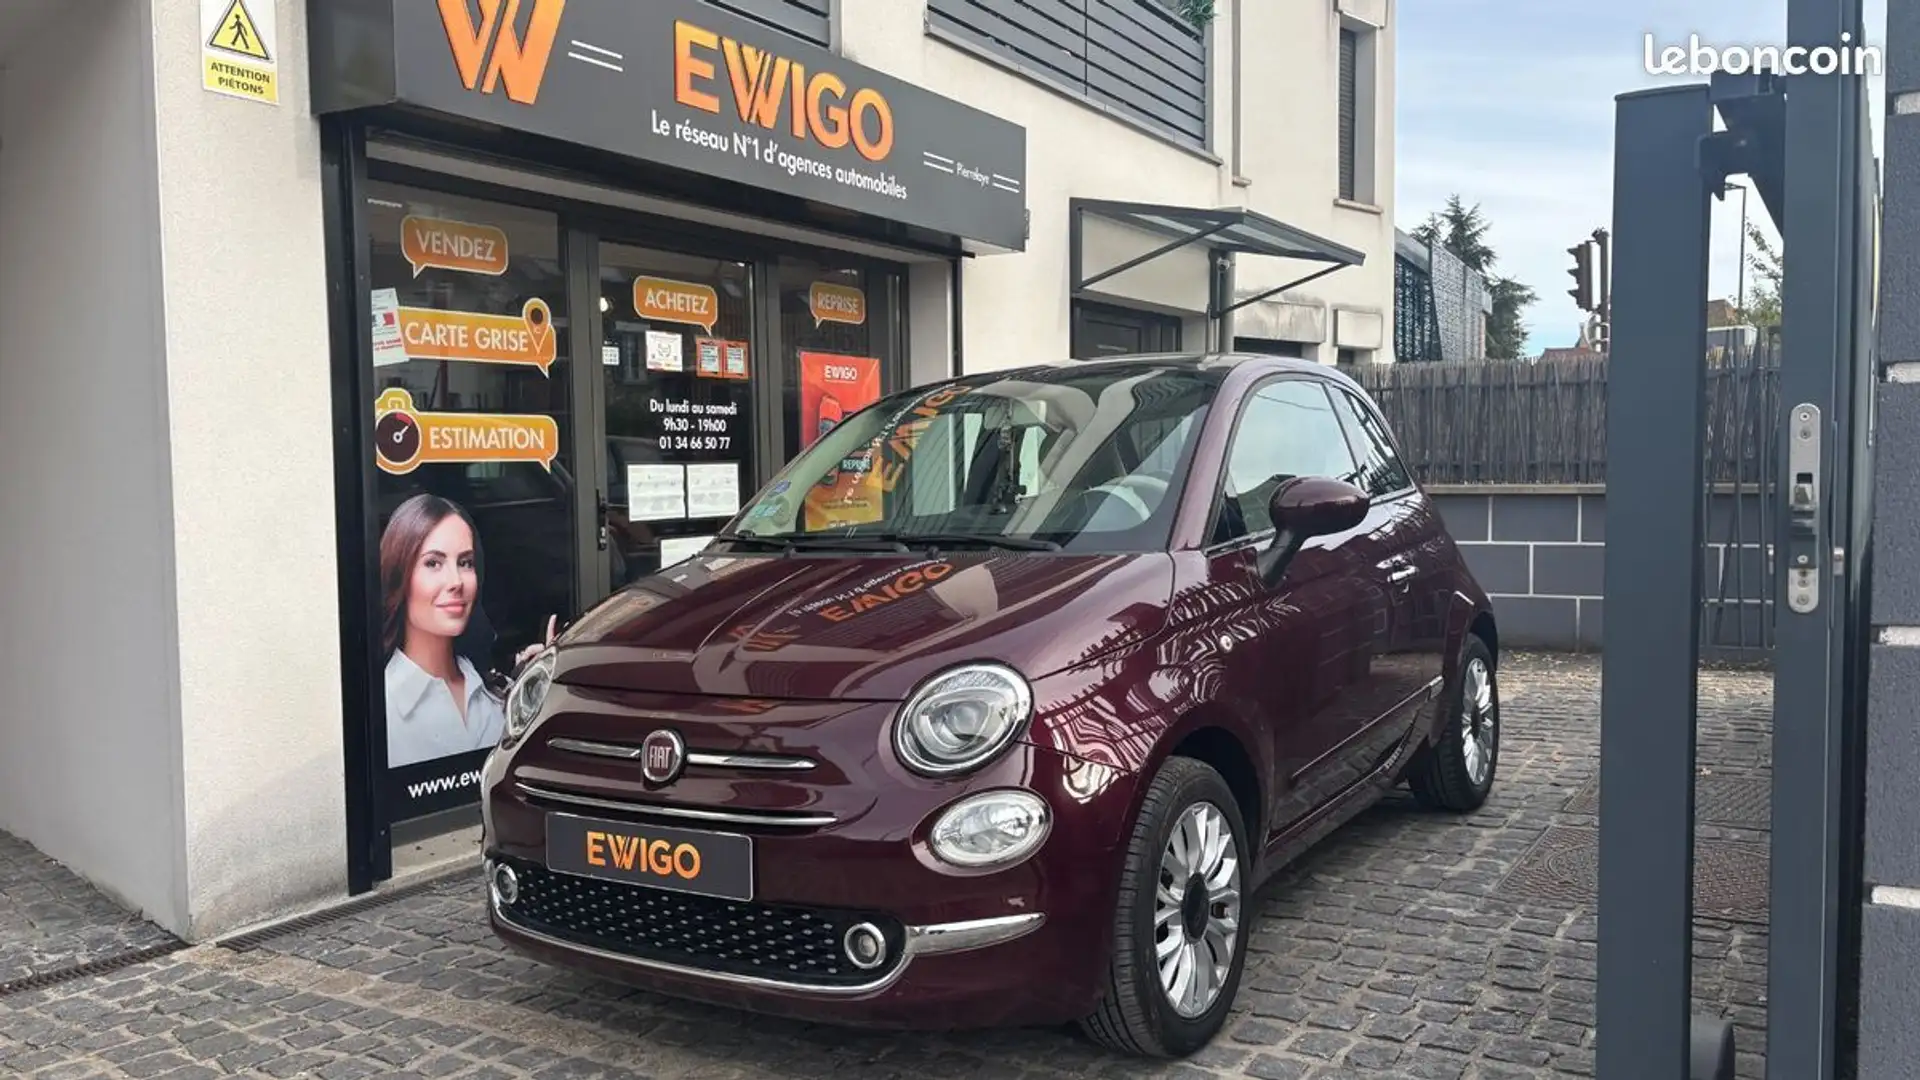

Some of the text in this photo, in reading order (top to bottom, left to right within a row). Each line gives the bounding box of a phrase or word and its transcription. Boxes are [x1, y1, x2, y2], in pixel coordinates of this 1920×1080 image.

[210, 61, 270, 84] ATTENTION
[218, 76, 264, 95] PIÉTONS
[674, 19, 894, 161] EWIGO
[651, 109, 671, 136] Le
[675, 118, 729, 152] réseau
[835, 167, 908, 200] automobiles
[415, 228, 497, 262] VENDEZ
[645, 287, 709, 315] ACHETEZ
[817, 291, 859, 315] REPRISE
[404, 321, 469, 348] CARTE
[474, 327, 529, 353] GRISE
[824, 364, 857, 381] EWIGO
[650, 398, 737, 415] Du lundi au samedi
[664, 417, 688, 431] 9h30
[697, 418, 727, 432] 19h00
[429, 426, 545, 450] ESTIMATION
[659, 436, 731, 450] 01 34 66 50 77
[649, 745, 673, 769] FIAT
[586, 831, 701, 879] EWIGO
